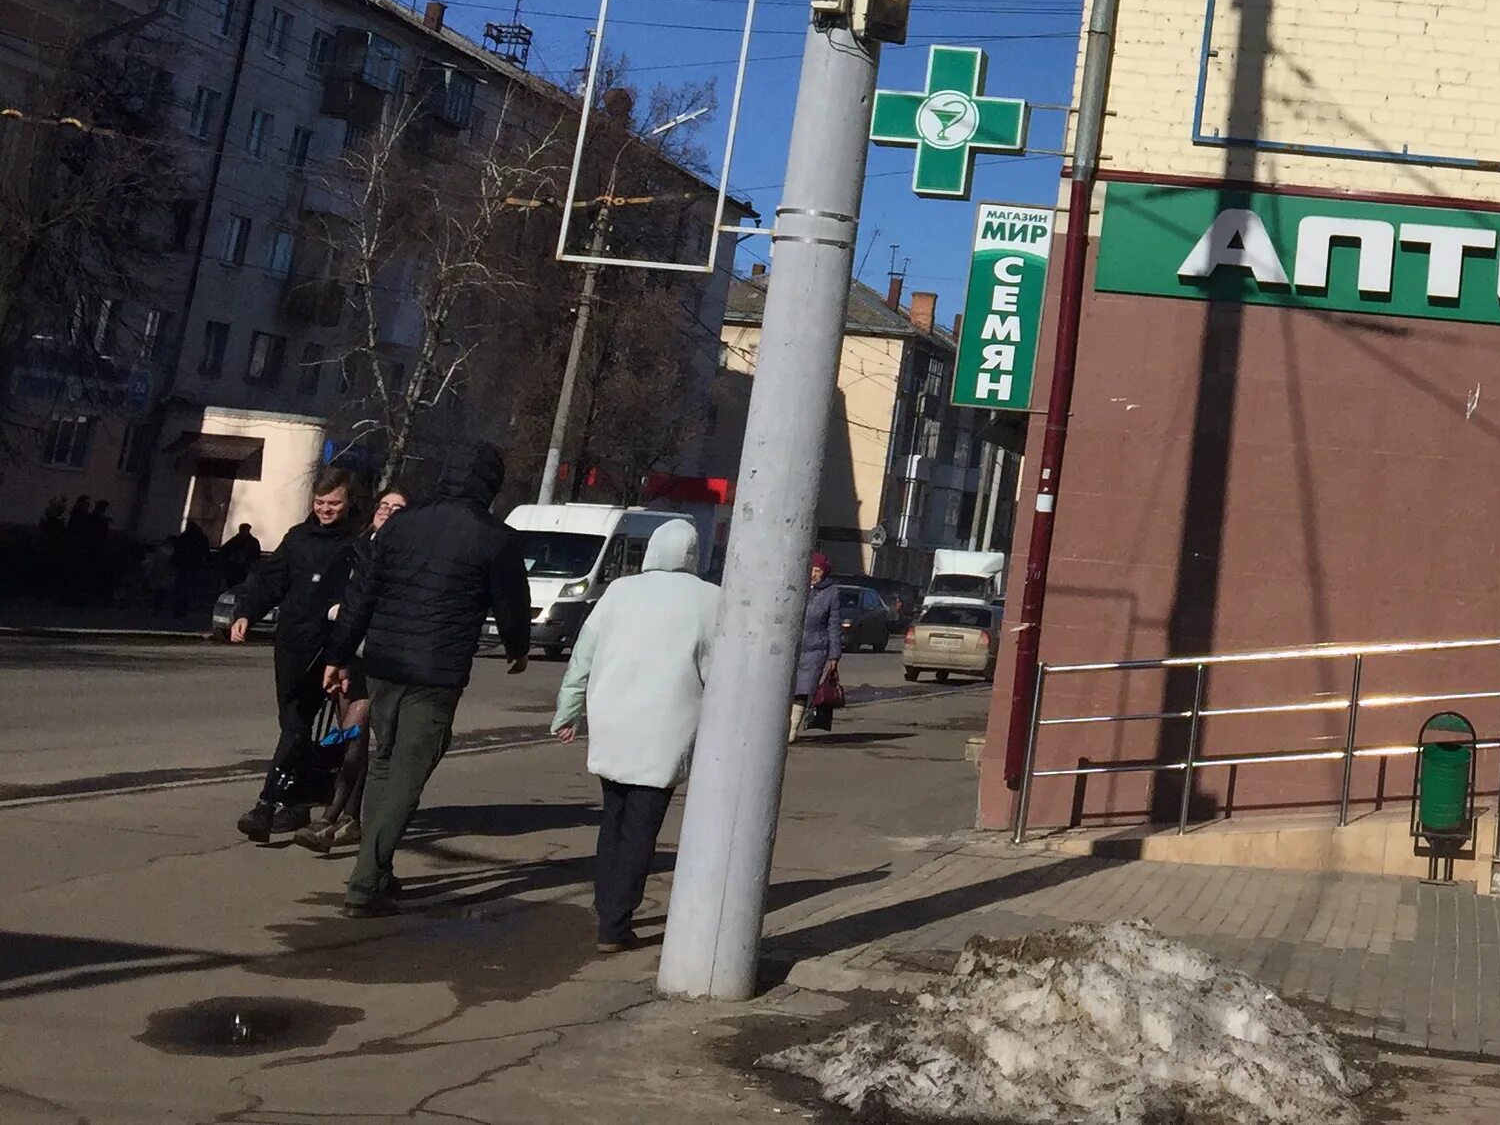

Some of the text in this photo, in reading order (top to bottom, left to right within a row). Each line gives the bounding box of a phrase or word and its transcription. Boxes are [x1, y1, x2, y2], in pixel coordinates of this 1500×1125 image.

[986, 210, 1048, 224] МАГАЗИН
[981, 222, 1048, 244] МИР
[975, 256, 1025, 401] СЕМЯН
